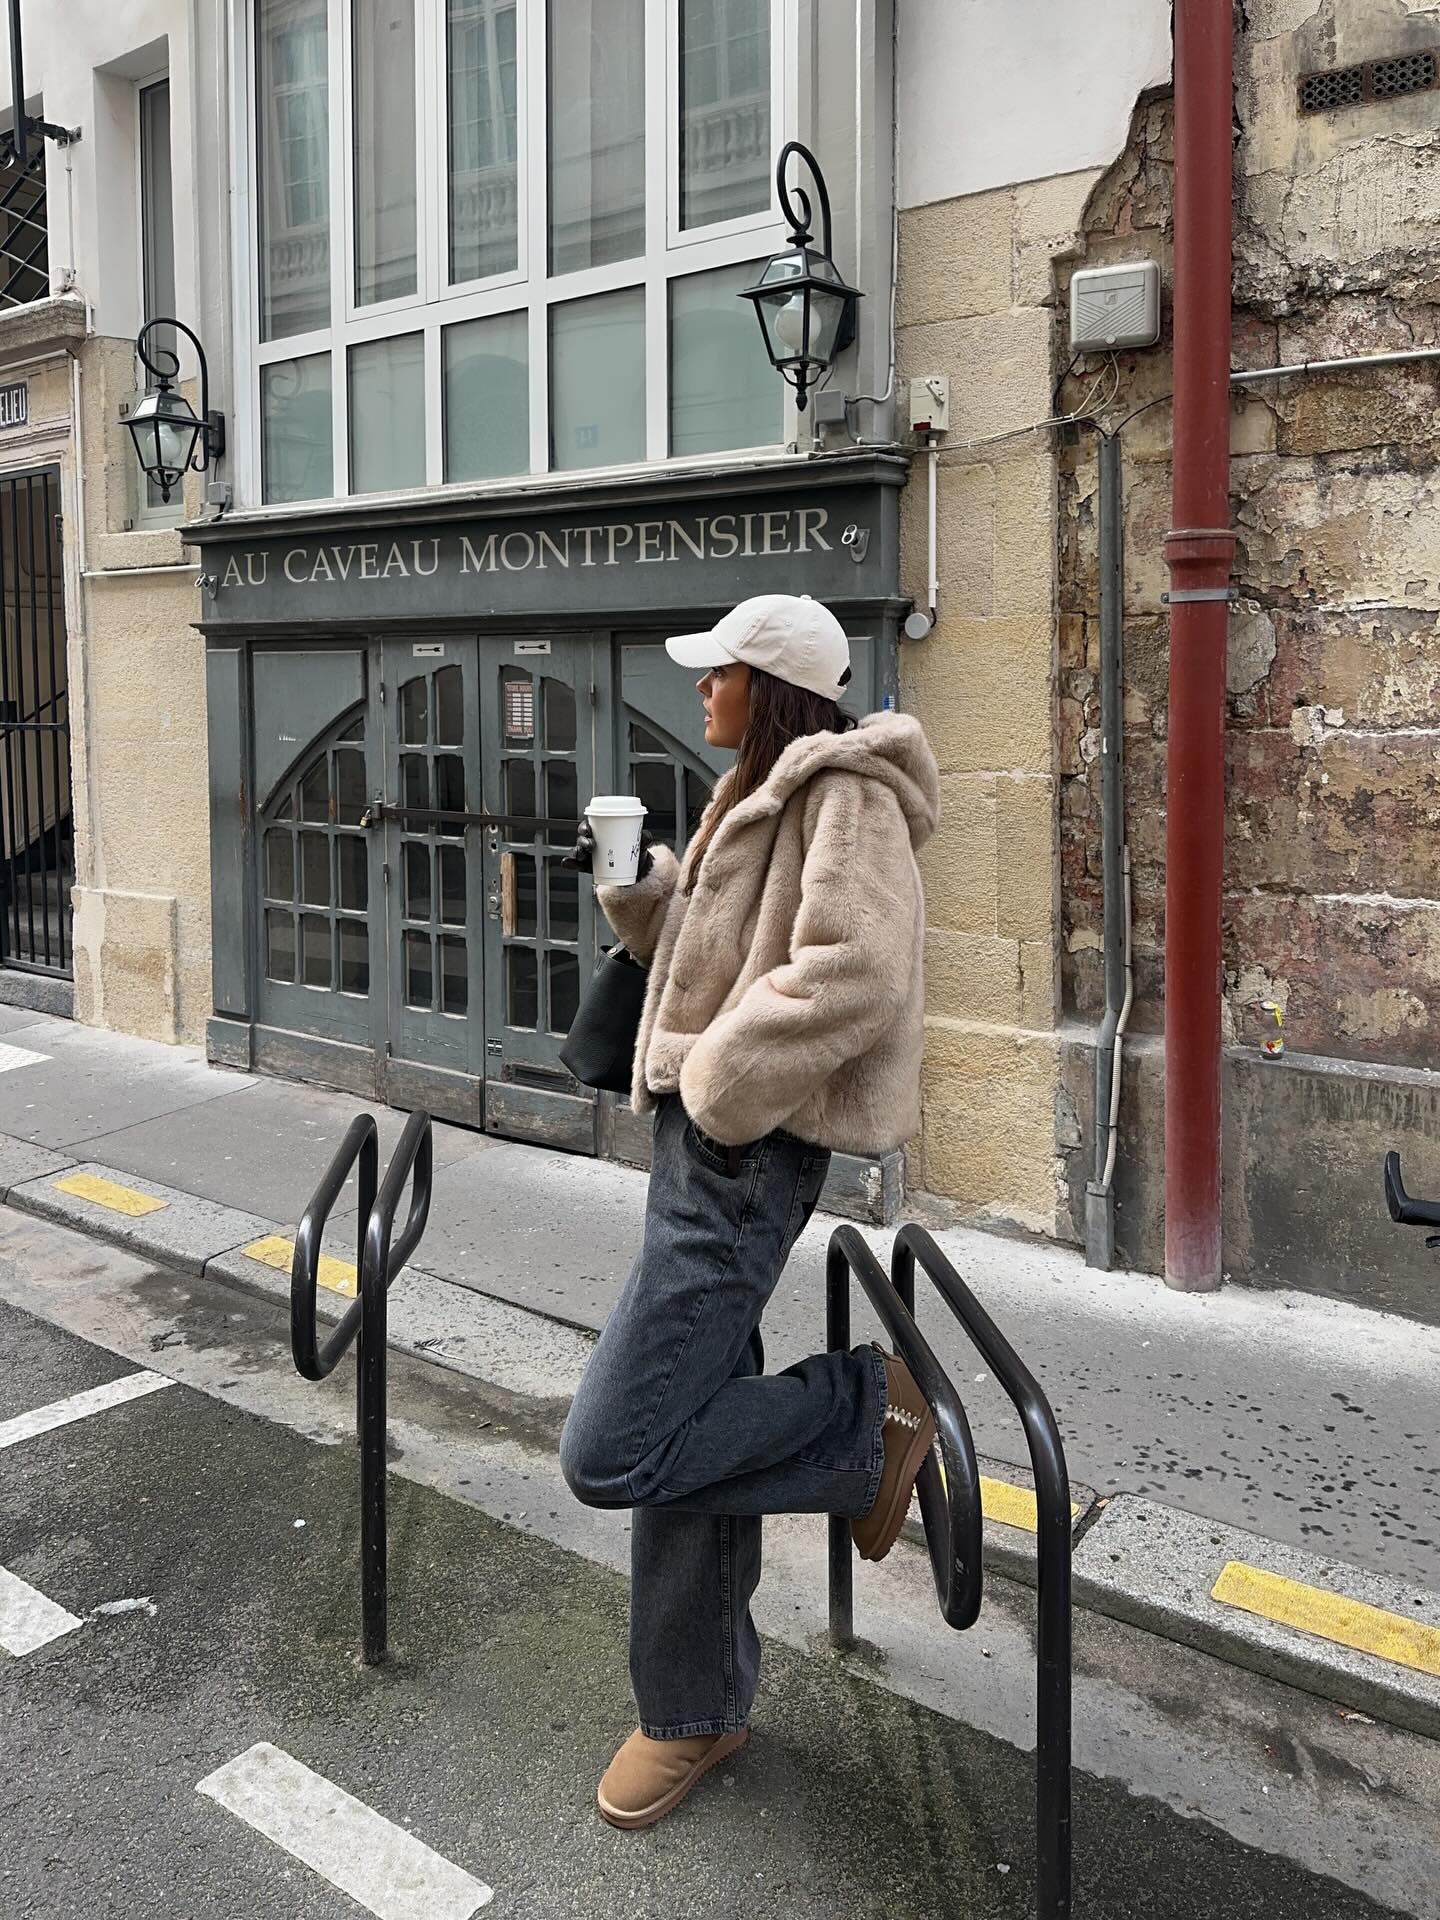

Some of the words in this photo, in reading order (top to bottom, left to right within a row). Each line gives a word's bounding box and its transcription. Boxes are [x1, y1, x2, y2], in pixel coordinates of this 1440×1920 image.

[221, 552, 269, 588] AU
[282, 539, 441, 584] CAVEAU
[458, 507, 834, 574] MONTPENSIER
